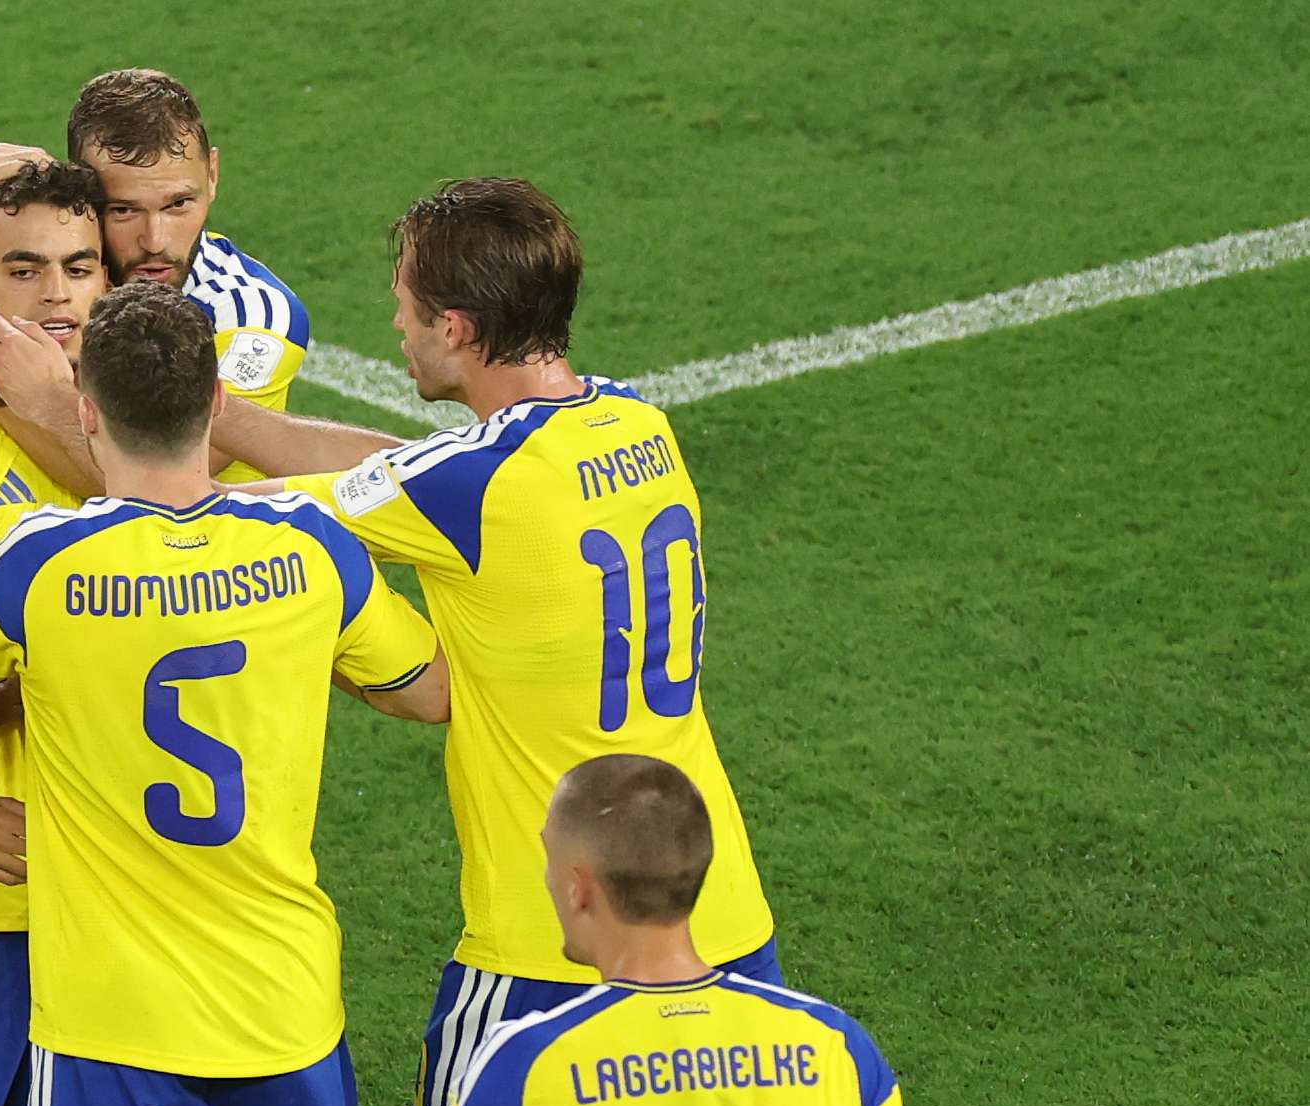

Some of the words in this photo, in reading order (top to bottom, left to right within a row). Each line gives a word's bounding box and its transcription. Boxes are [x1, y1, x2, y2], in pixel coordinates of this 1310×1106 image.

[577, 434, 675, 501] NYGREN
[65, 551, 307, 618] GUDMUNDSSON
[580, 503, 707, 732] 10
[143, 639, 247, 847] 5
[571, 1044, 819, 1105] LAGERBIELKE
